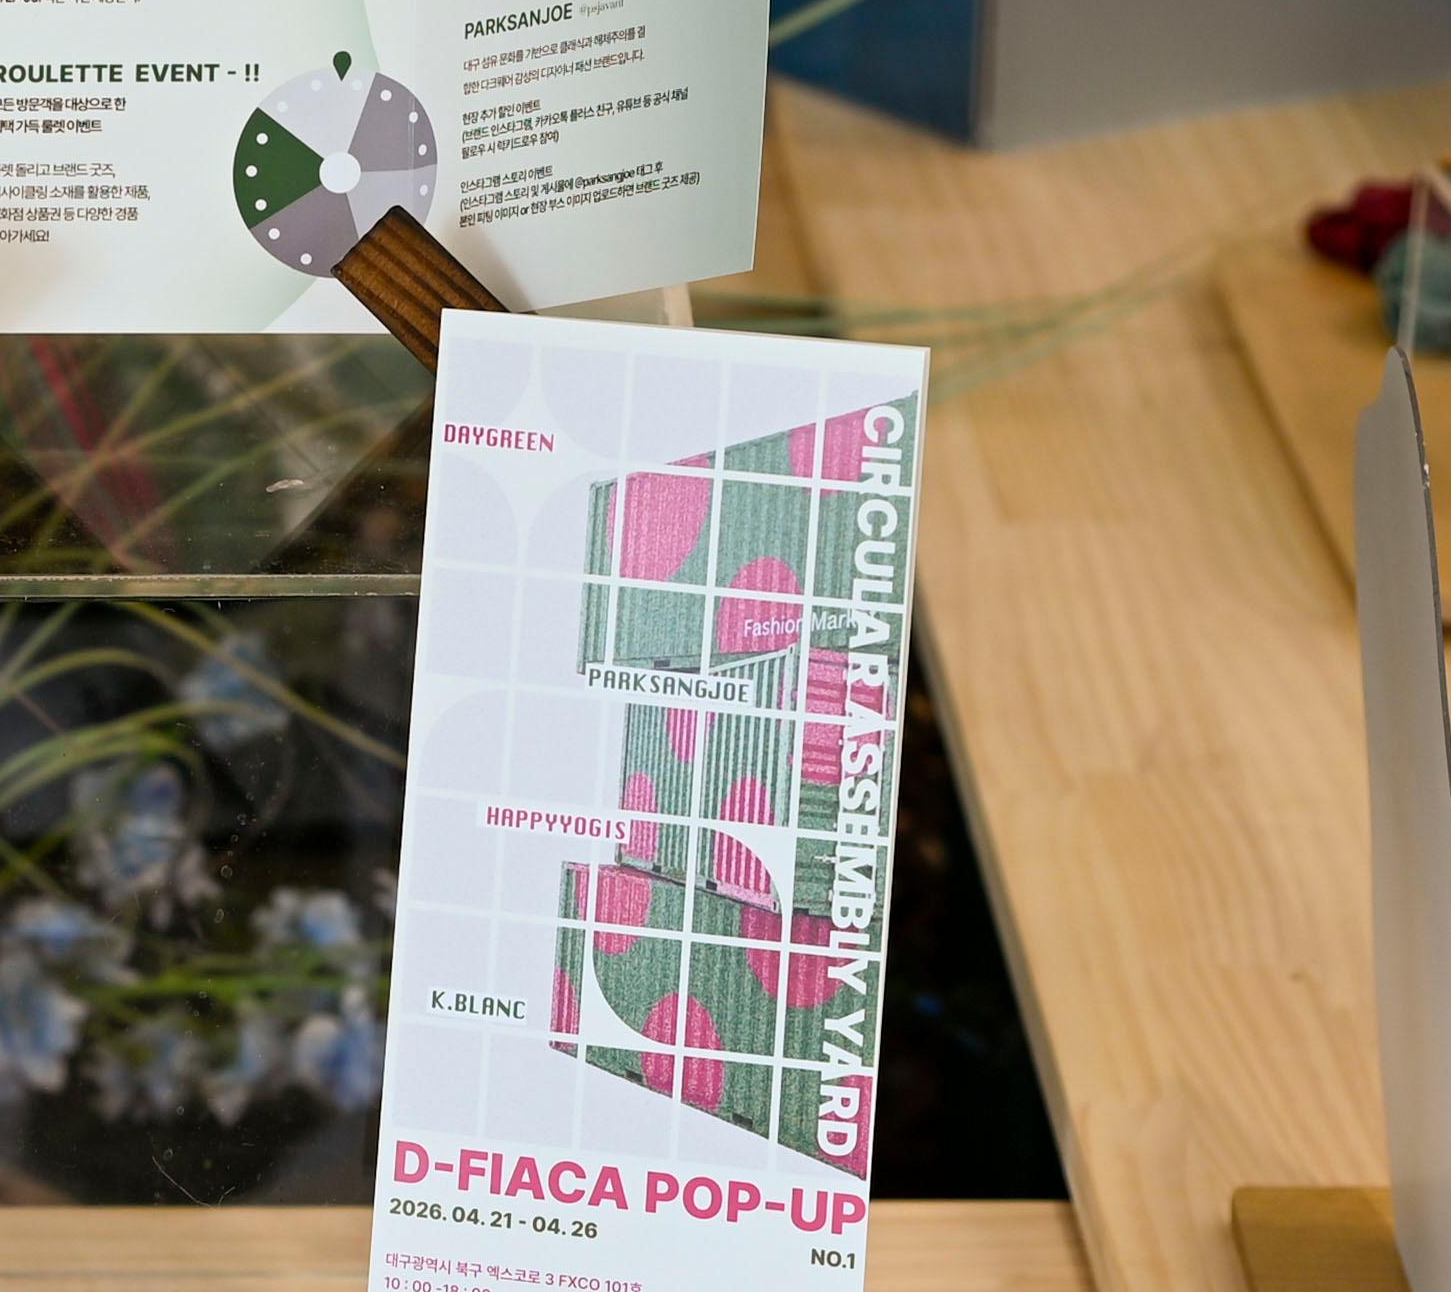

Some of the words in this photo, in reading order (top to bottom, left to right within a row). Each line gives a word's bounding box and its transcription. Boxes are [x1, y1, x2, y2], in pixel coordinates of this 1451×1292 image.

[464, 3, 573, 40] PARKSANJOE
[135, 64, 220, 82] EVENT
[245, 64, 260, 82] !!
[443, 423, 555, 453] DAYGREEN
[846, 405, 905, 689] CIRCULAR
[588, 667, 750, 704] PARKSANGJOE
[486, 806, 626, 841] HAPPYYOGIS
[827, 700, 884, 997] ASSEMBLY
[431, 990, 526, 1020] K.BLANC
[817, 1008, 866, 1158] YARD
[393, 1140, 630, 1211] D-FIACA
[645, 1170, 866, 1236] POP-UP
[389, 1198, 447, 1223] 2026.
[451, 1205, 486, 1228] 04.
[489, 1210, 513, 1230] 21
[532, 1215, 567, 1236] 04.
[571, 1220, 598, 1239] 26
[384, 1252, 452, 1276] 대구광역시
[456, 1260, 483, 1279] 북구
[486, 1263, 541, 1286] 엑스코로
[544, 1272, 554, 1286] 3
[558, 1275, 601, 1291] FXCO
[810, 1247, 856, 1270] NO.1
